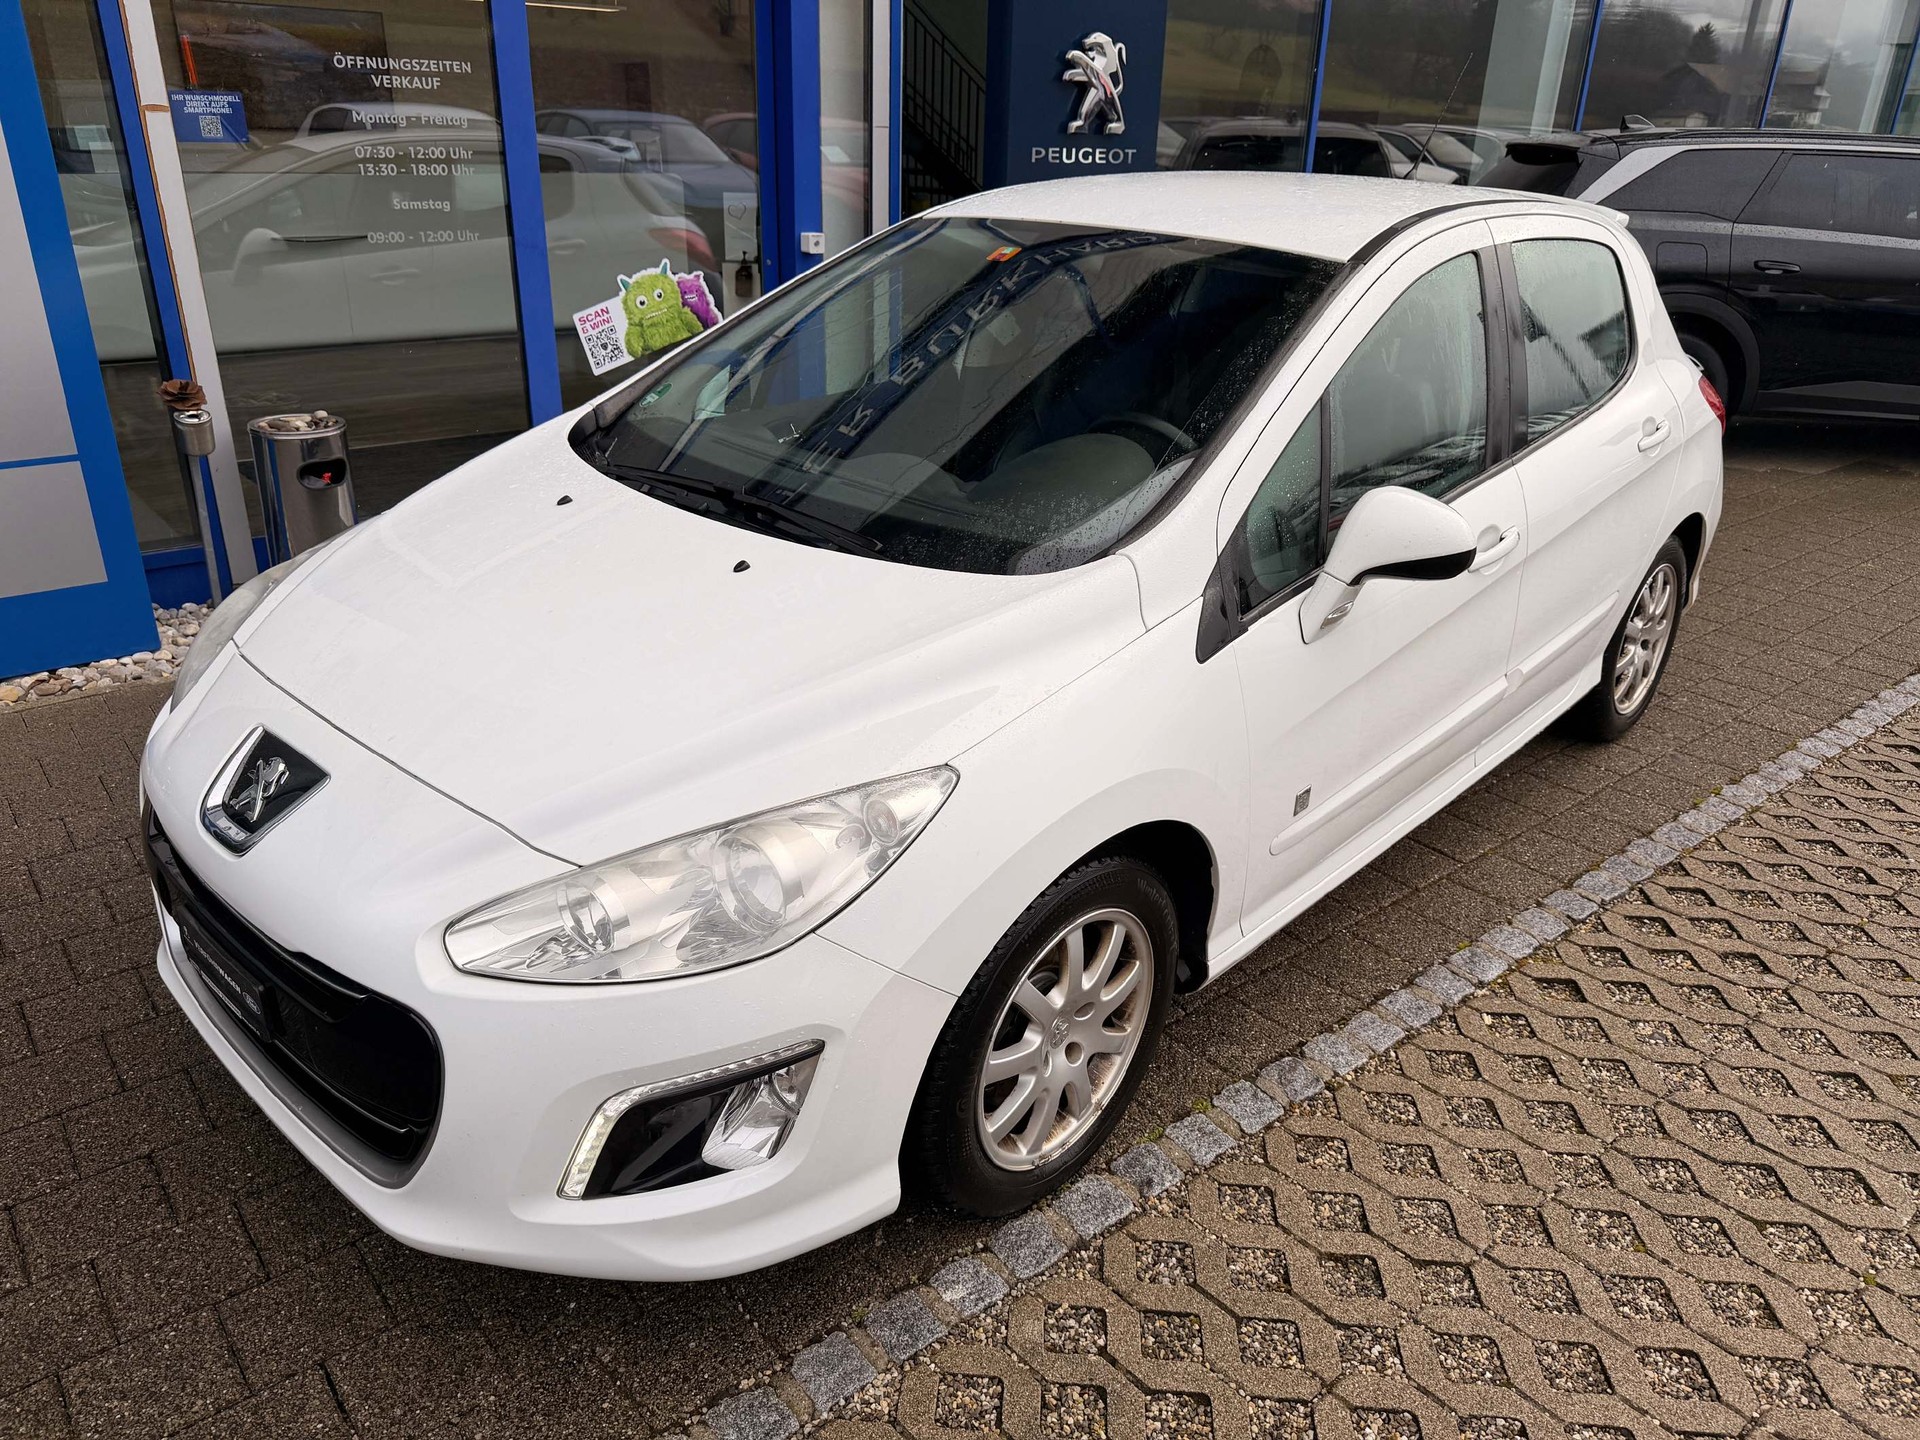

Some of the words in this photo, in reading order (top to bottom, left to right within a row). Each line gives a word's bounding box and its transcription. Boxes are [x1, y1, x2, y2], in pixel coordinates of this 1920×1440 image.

[333, 52, 472, 74] ÖFFNUNGSZEITEN
[371, 75, 441, 90] VERKAUF
[184, 94, 240, 102] WUNSCHMODELL
[352, 110, 407, 127] Montag
[421, 114, 468, 128] Freitag
[354, 146, 396, 159] 07:30
[408, 146, 447, 159] 12:00
[450, 146, 474, 160] Uhr
[1031, 147, 1137, 164] PEUGEOT
[358, 163, 398, 176] 13:30
[410, 163, 449, 176] 18:00
[451, 164, 475, 176] Uhr
[393, 198, 451, 212] Samstag
[367, 231, 405, 244] 09:00
[419, 230, 454, 243] 12:00
[457, 230, 480, 242] Uhr
[578, 306, 610, 326] SCAN
[589, 316, 613, 331] WIN!
